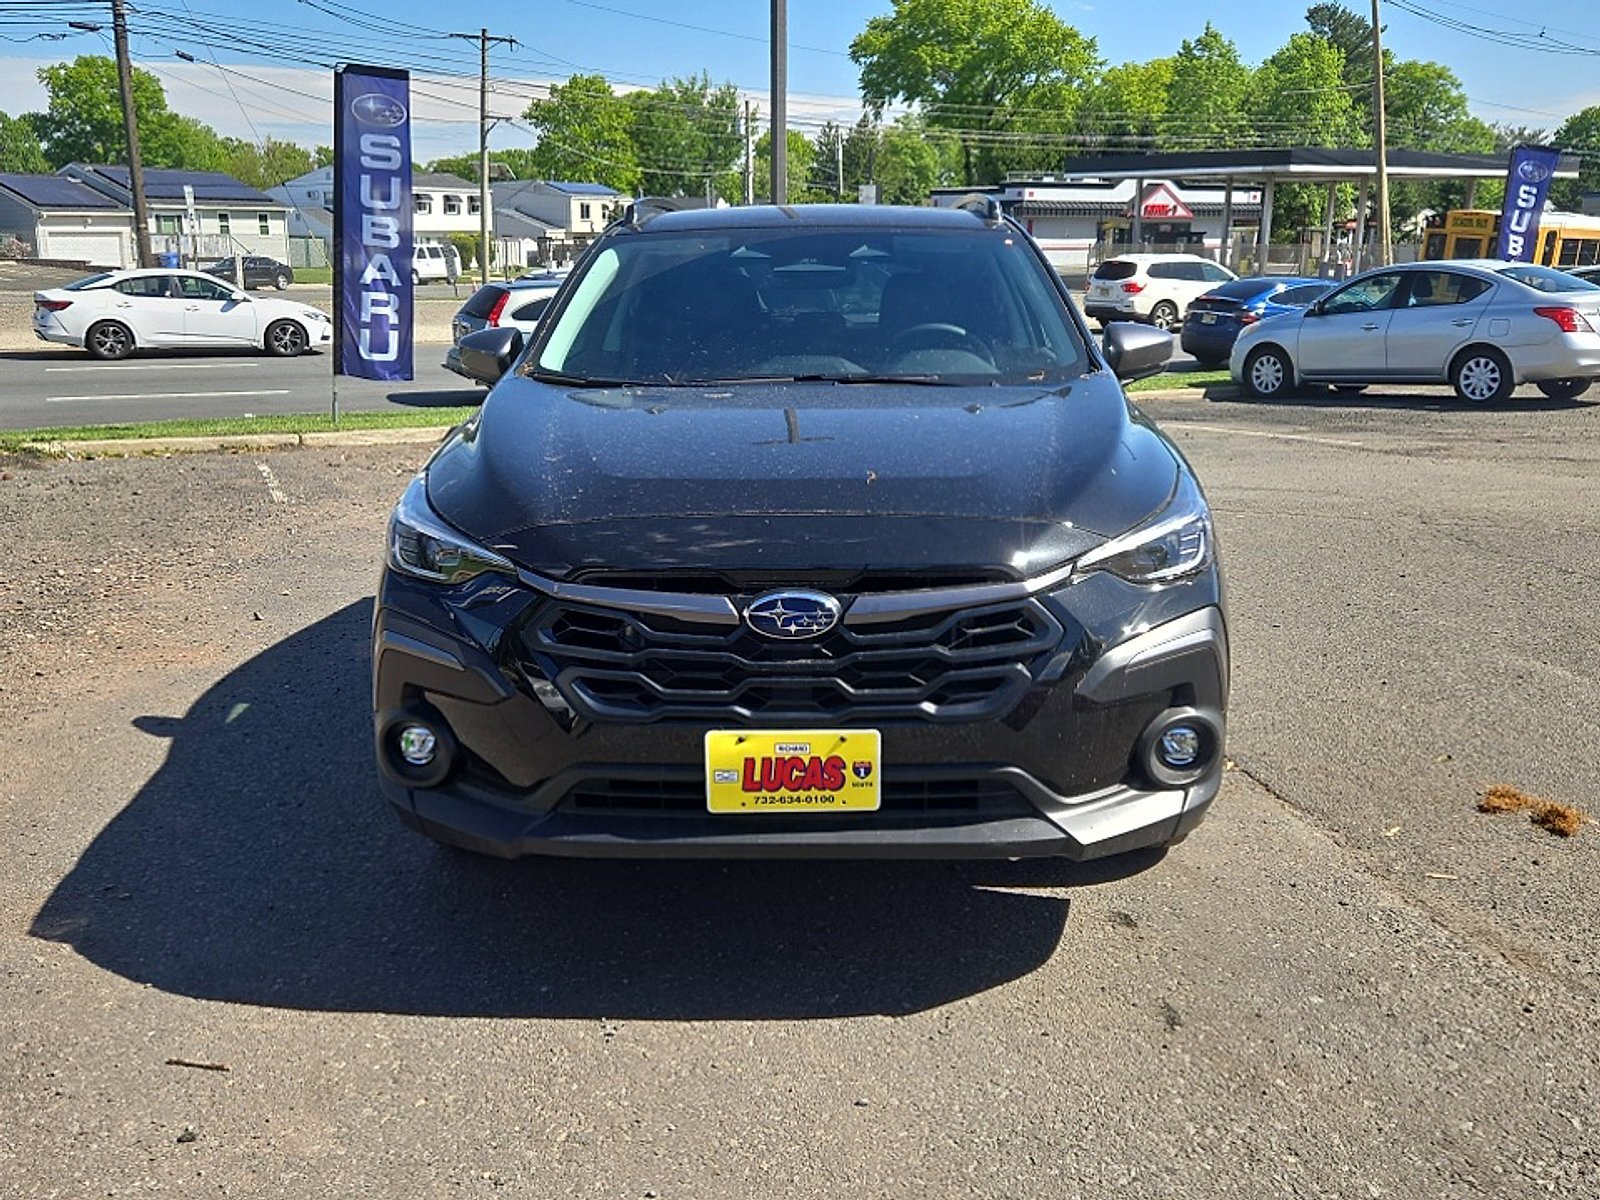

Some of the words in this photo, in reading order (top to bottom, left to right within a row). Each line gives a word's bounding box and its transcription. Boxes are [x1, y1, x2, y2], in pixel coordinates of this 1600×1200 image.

[359, 133, 402, 362] SUBARU
[1508, 184, 1537, 258] SUB
[742, 755, 846, 792] LUCAS
[753, 795, 835, 805] 732-634-0100
